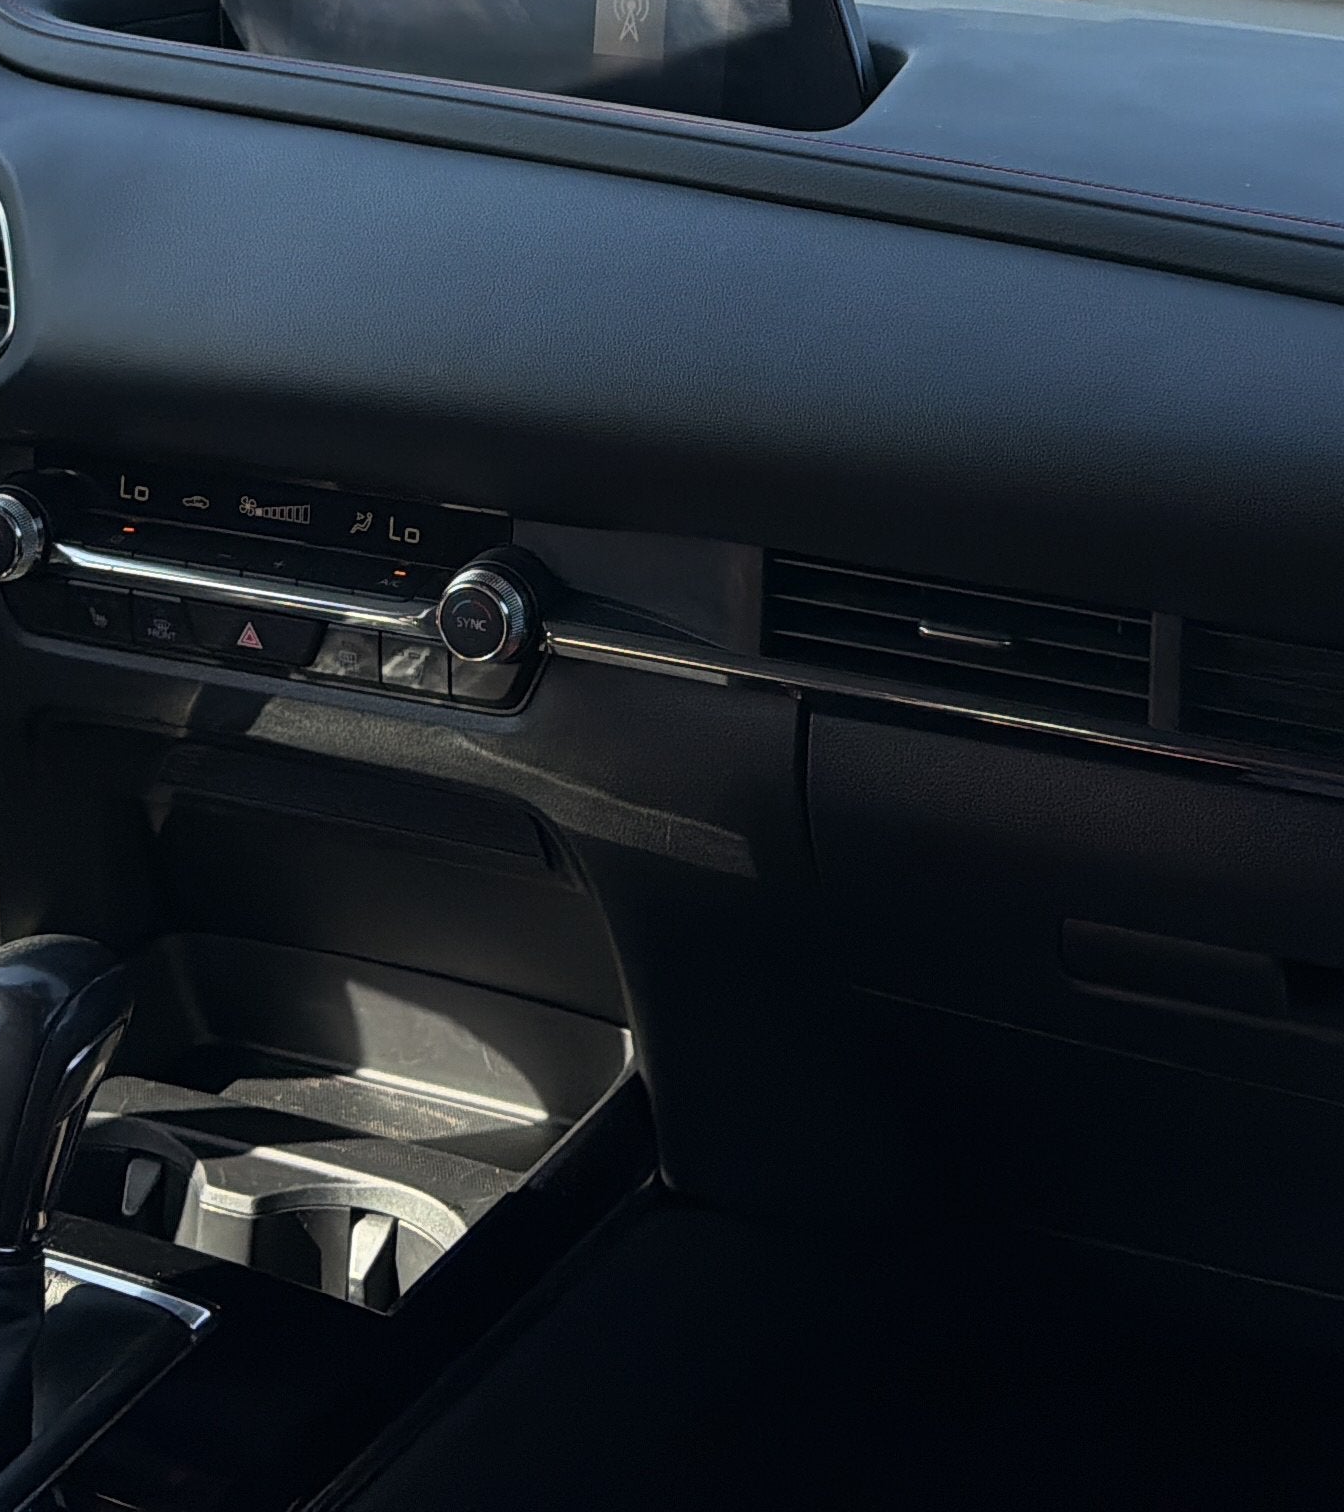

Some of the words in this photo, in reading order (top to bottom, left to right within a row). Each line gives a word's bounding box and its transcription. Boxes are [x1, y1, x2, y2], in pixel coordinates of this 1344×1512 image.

[119, 475, 150, 502] Lo
[388, 515, 421, 544] Lo
[377, 577, 401, 588] A/C
[456, 616, 488, 633] SYNC
